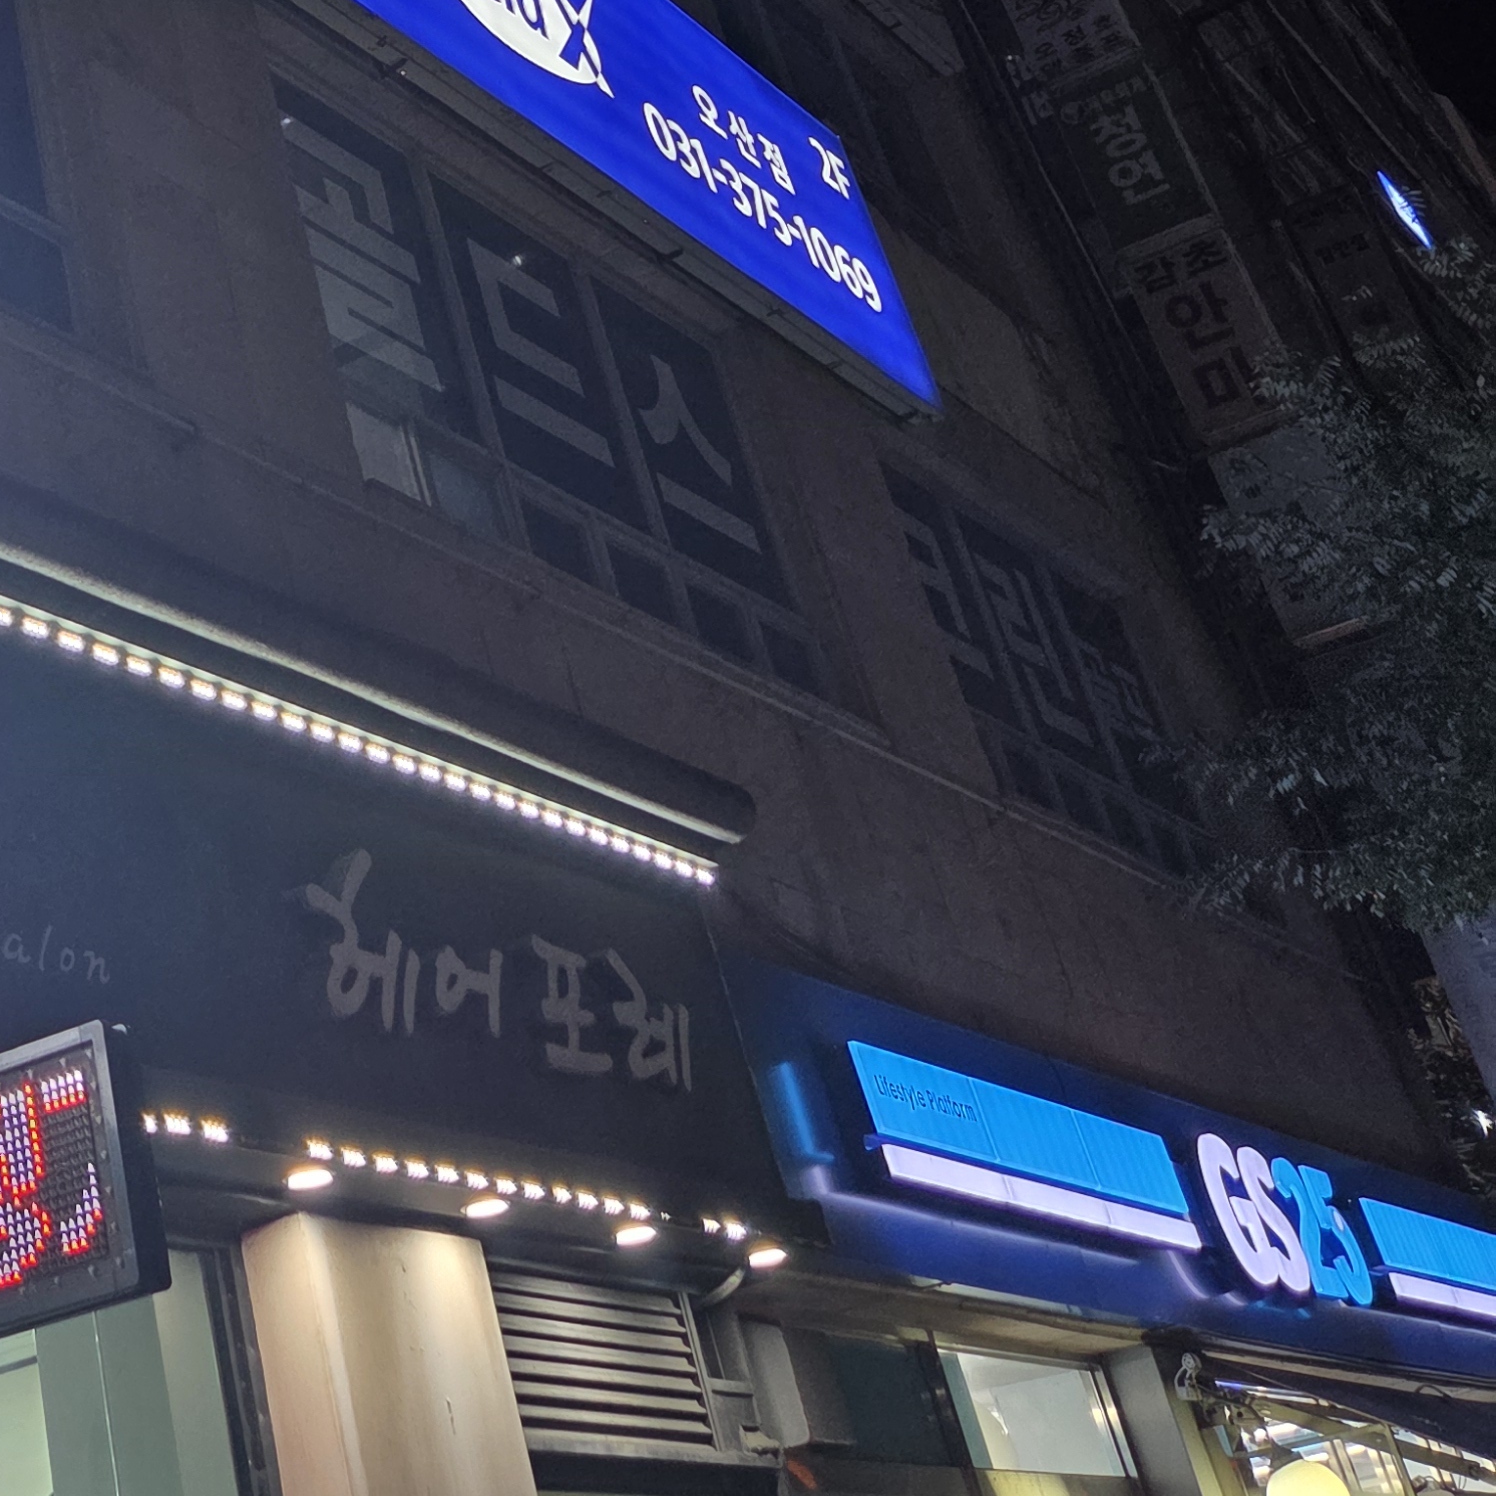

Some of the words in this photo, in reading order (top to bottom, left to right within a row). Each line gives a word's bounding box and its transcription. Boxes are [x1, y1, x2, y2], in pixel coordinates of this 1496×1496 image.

[642, 102, 883, 313] 031-375-1069
[691, 85, 796, 195] 오산점
[809, 136, 850, 200] 2F
[305, 848, 503, 1037] 헤어
[531, 934, 692, 1092] 포레
[873, 1074, 927, 1111] Lifestyle
[925, 1090, 978, 1122] Platform
[1197, 1132, 1374, 1306] GS25
